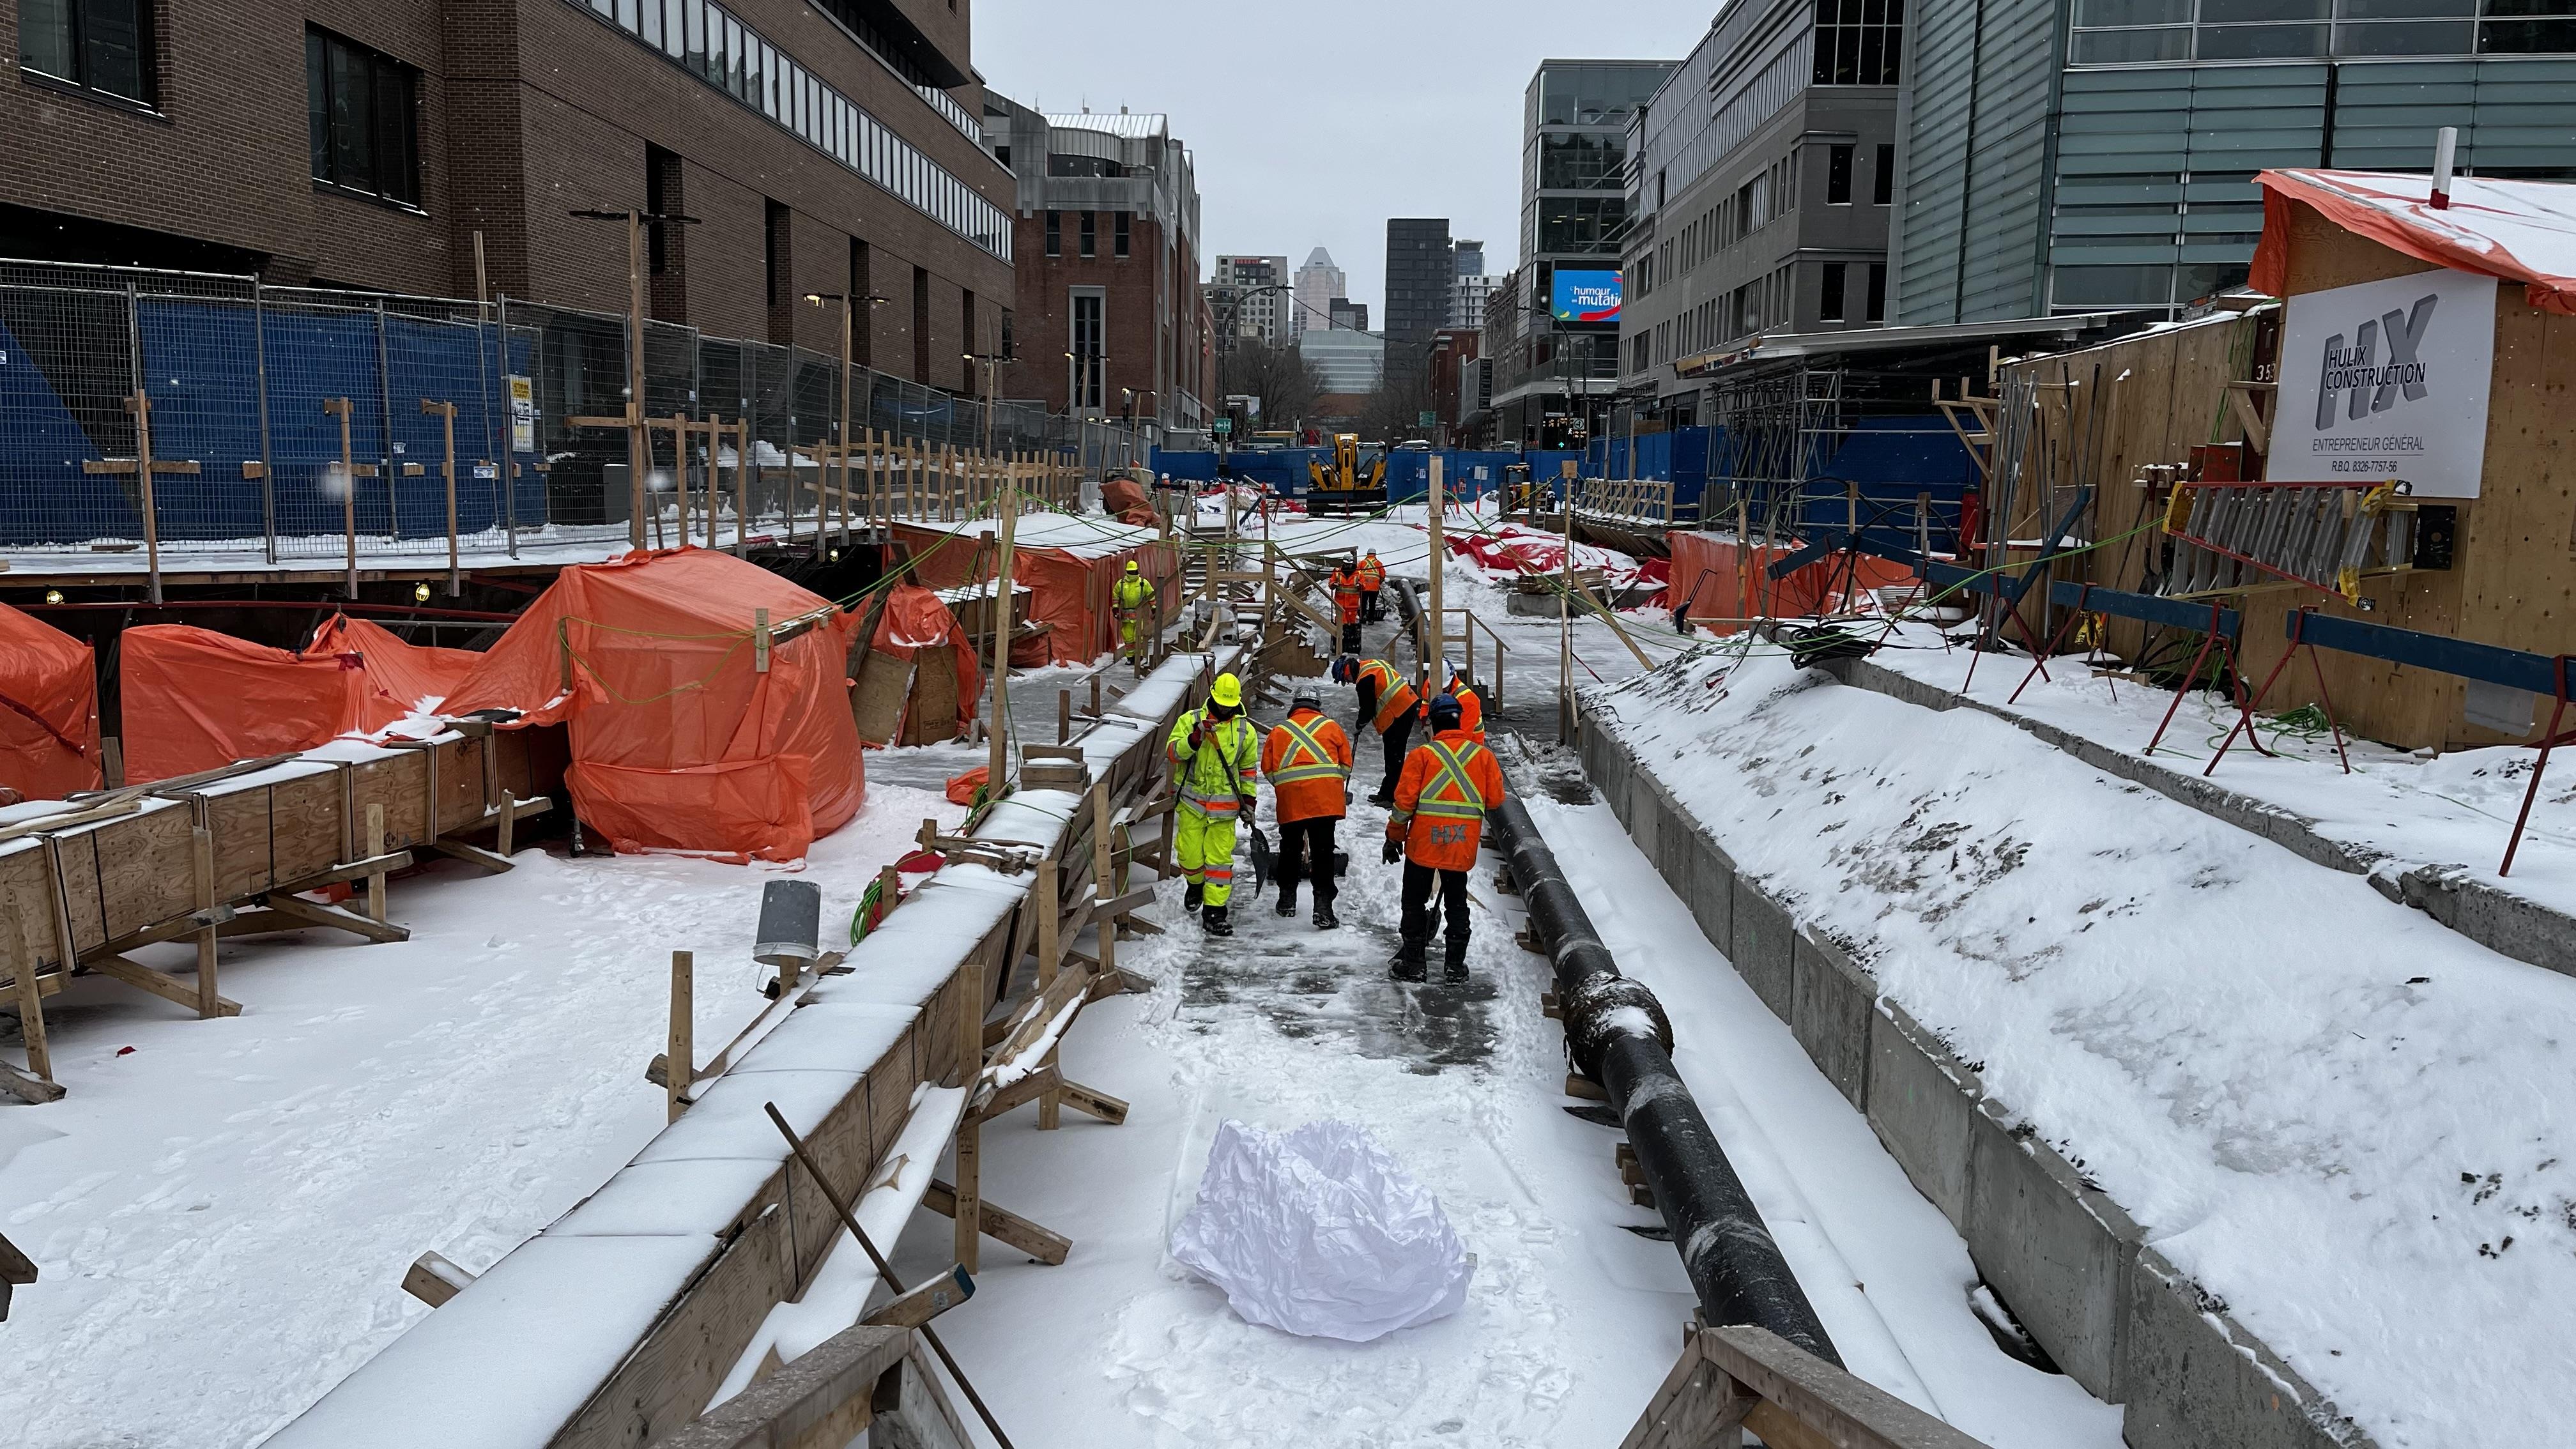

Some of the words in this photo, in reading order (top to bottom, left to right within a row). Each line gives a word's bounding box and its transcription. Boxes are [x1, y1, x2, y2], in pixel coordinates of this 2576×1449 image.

[2329, 346, 2367, 369] HULIX
[2326, 362, 2426, 390] CONSTRUCTION
[2312, 437, 2380, 451] ENTREPRENEUR
[2382, 433, 2425, 450] GÉNÉRAL
[2352, 461, 2398, 472] 8326-7757-56
[1431, 824, 1468, 844] HX
